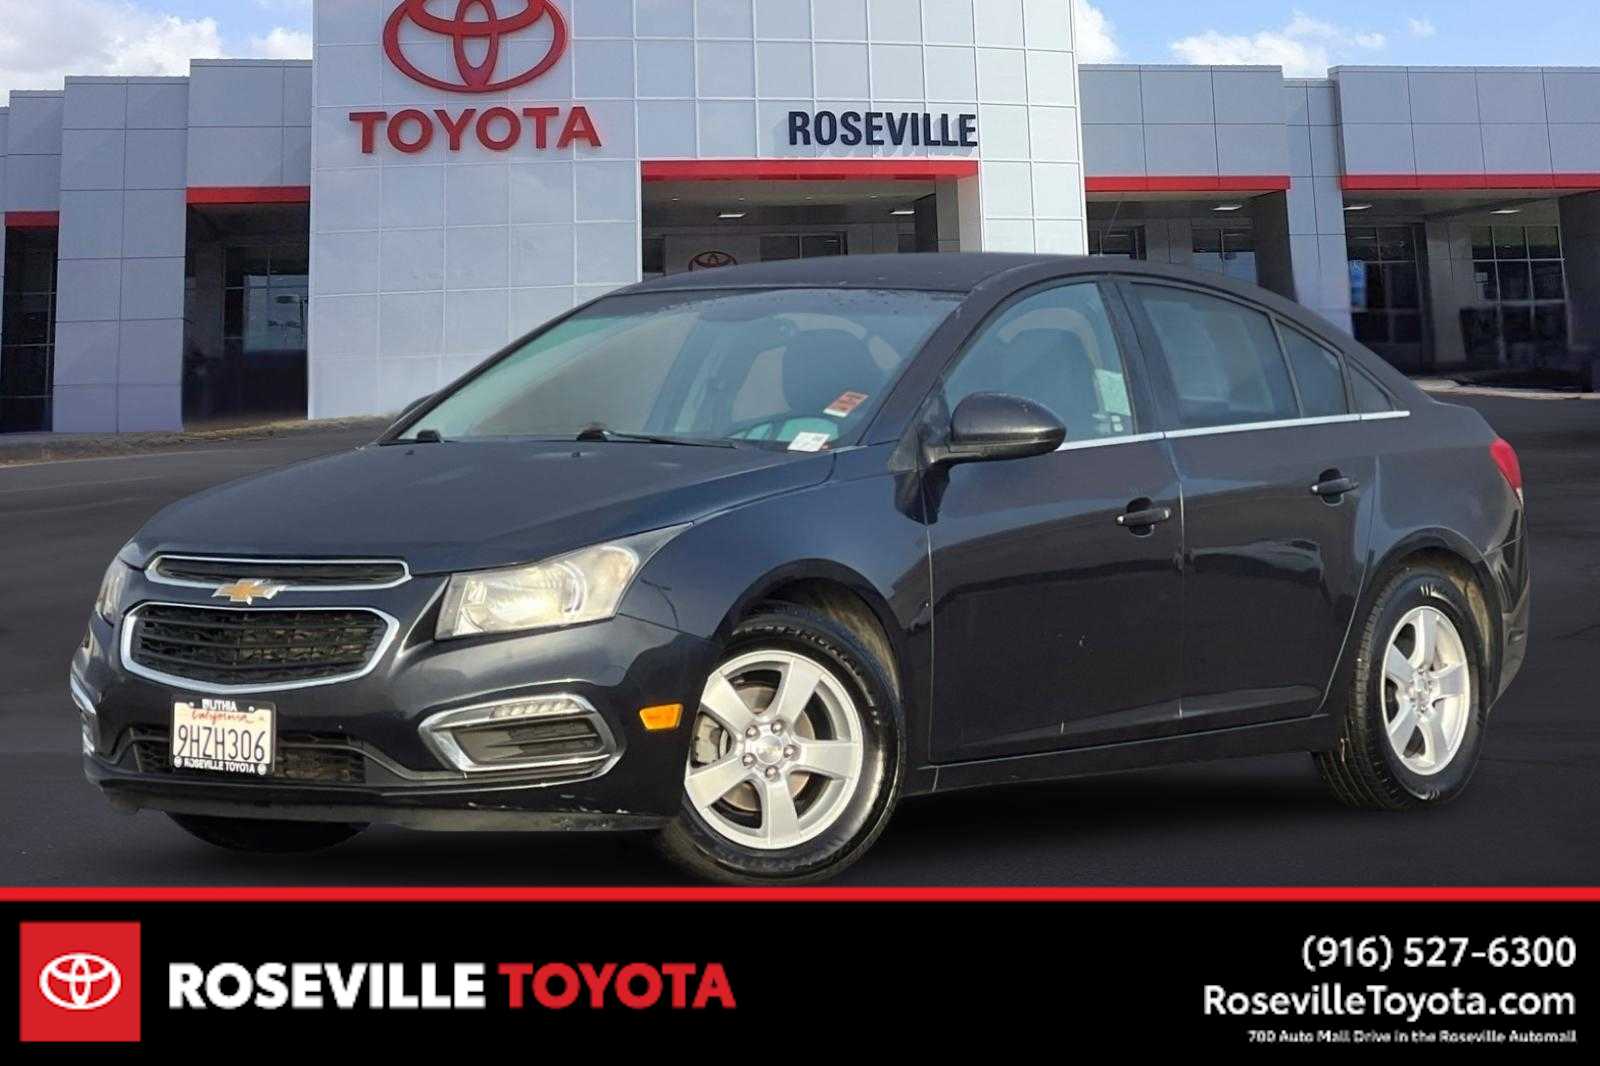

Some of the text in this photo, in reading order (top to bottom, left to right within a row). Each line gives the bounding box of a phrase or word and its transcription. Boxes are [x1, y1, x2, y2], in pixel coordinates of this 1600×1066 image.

[349, 106, 602, 154] TOYOTA
[788, 110, 978, 147] ROSEVILLE
[178, 724, 266, 762] 9HZH306
[225, 761, 255, 773] TOYOTA
